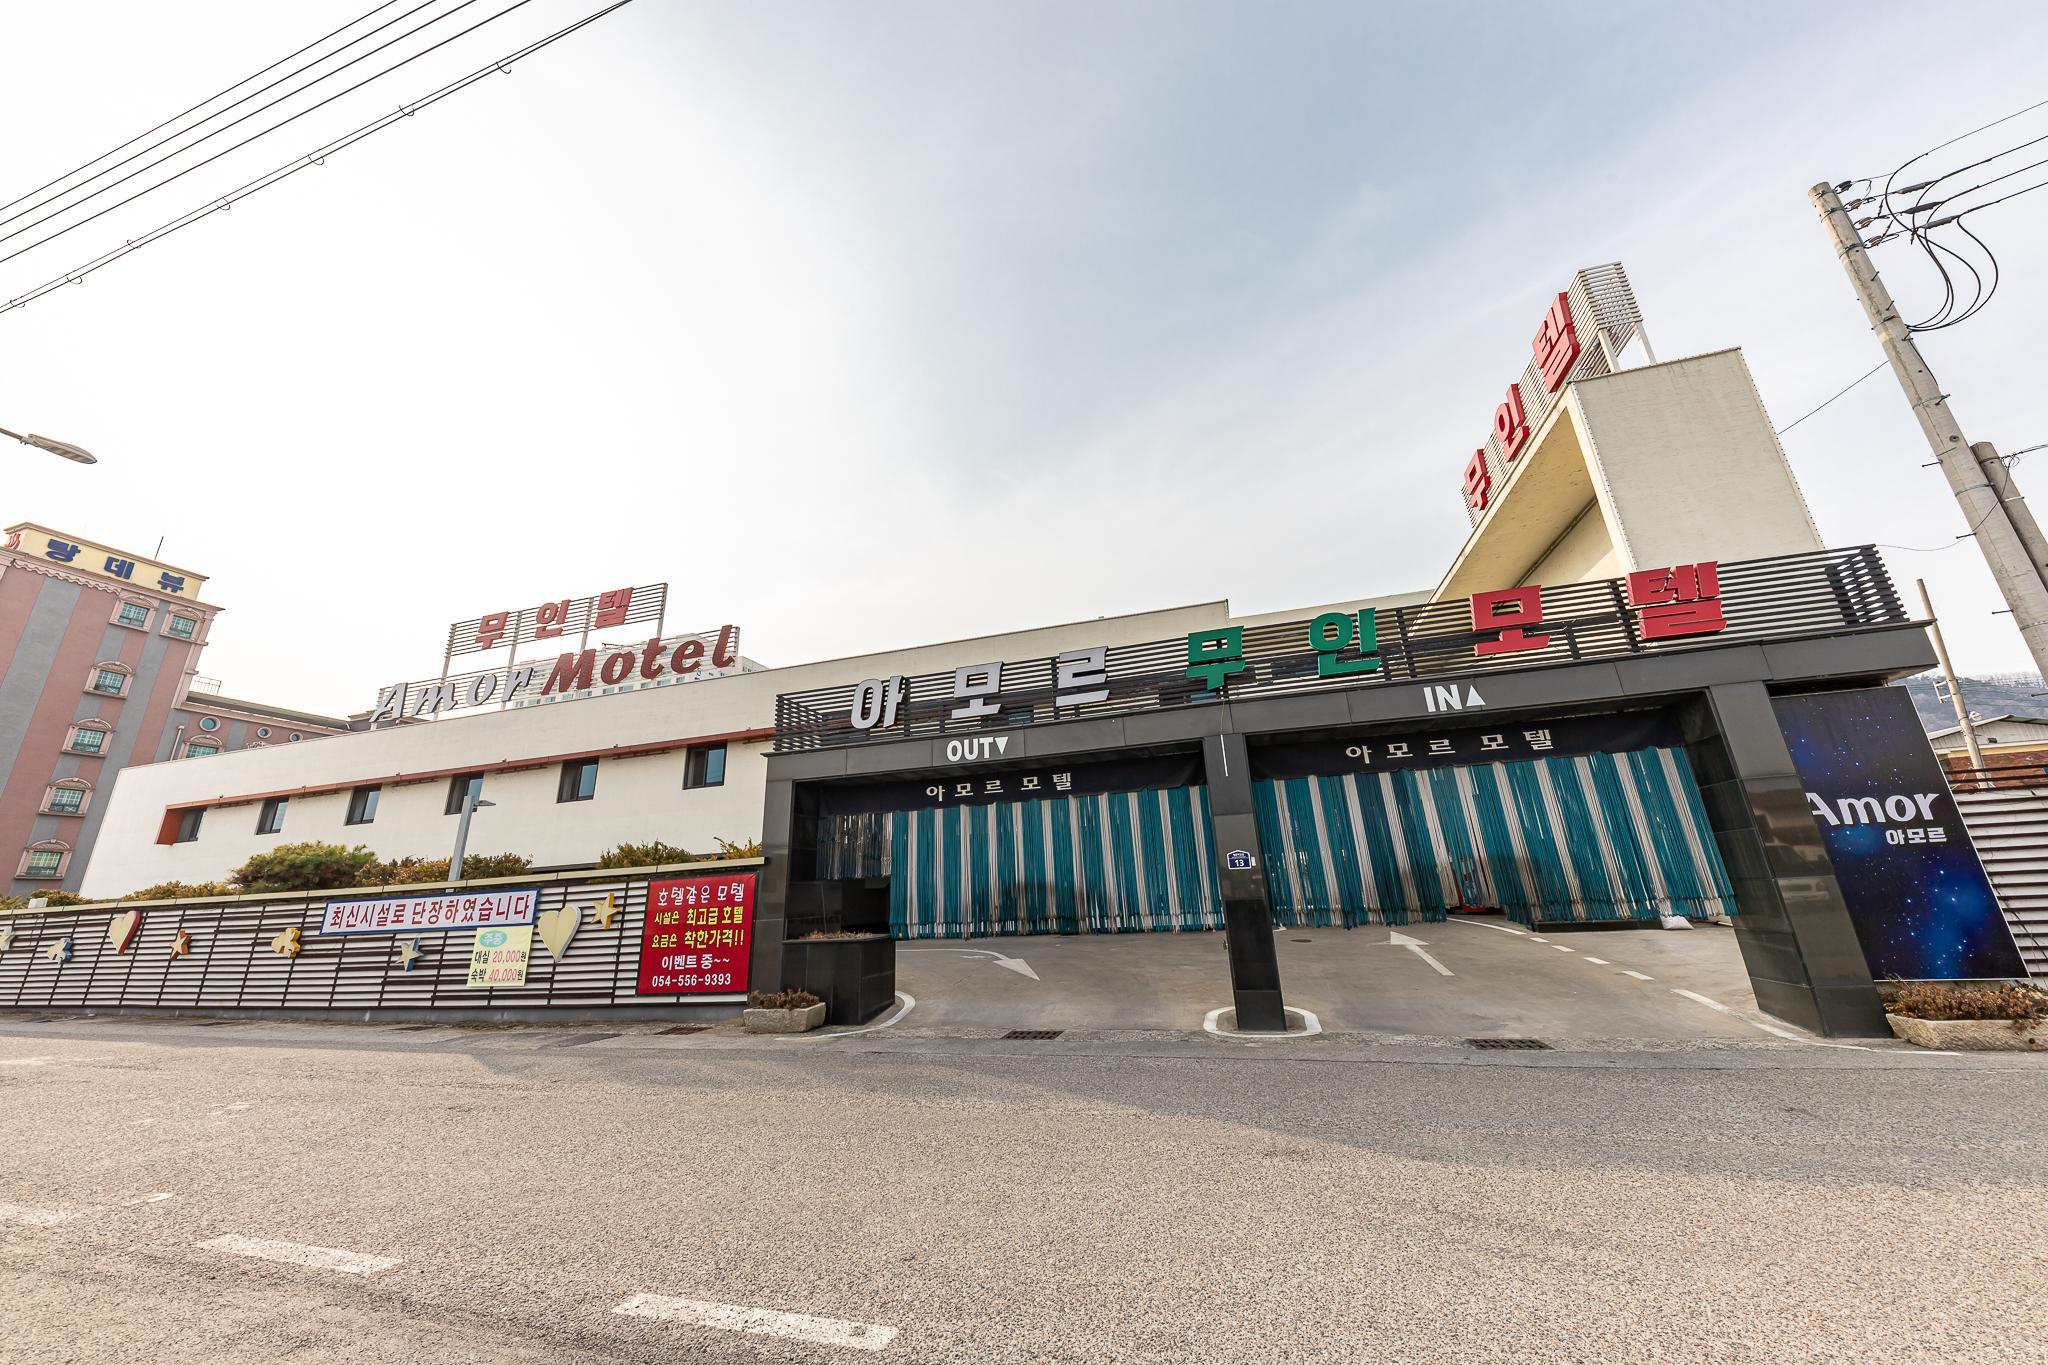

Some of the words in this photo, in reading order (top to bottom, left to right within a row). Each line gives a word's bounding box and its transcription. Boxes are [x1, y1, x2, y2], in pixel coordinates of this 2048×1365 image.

[1464, 292, 1580, 511] 무인텔
[475, 587, 634, 649] 무인텔
[850, 646, 1110, 729] 아모르
[1186, 607, 1382, 691] 무인
[1469, 561, 1727, 657] 모텔
[369, 667, 534, 723] Amor
[541, 624, 735, 696] Motel
[1423, 684, 1463, 713] IN
[946, 736, 994, 762] OUT
[1345, 738, 1456, 766] 아모르
[1480, 729, 1553, 751] 모텔
[926, 779, 1004, 802] 아모르
[1021, 772, 1072, 791] 모텔
[1805, 792, 1940, 826] Amor
[1885, 827, 1948, 846] 아모르
[1234, 859, 1245, 867] 13
[658, 885, 710, 906] 호텔같은
[717, 882, 745, 902] 모텔
[330, 903, 407, 929] 최신시설로
[411, 894, 531, 925] 단장하였습니다
[654, 911, 680, 925] 시설은
[686, 907, 719, 926] 최고급
[721, 906, 744, 924] 호텔
[652, 933, 678, 948] 요금은
[475, 950, 490, 964] 대실
[661, 954, 698, 970] 이벤트
[471, 968, 486, 982] 숙박
[652, 973, 731, 987] 054-556-9393
